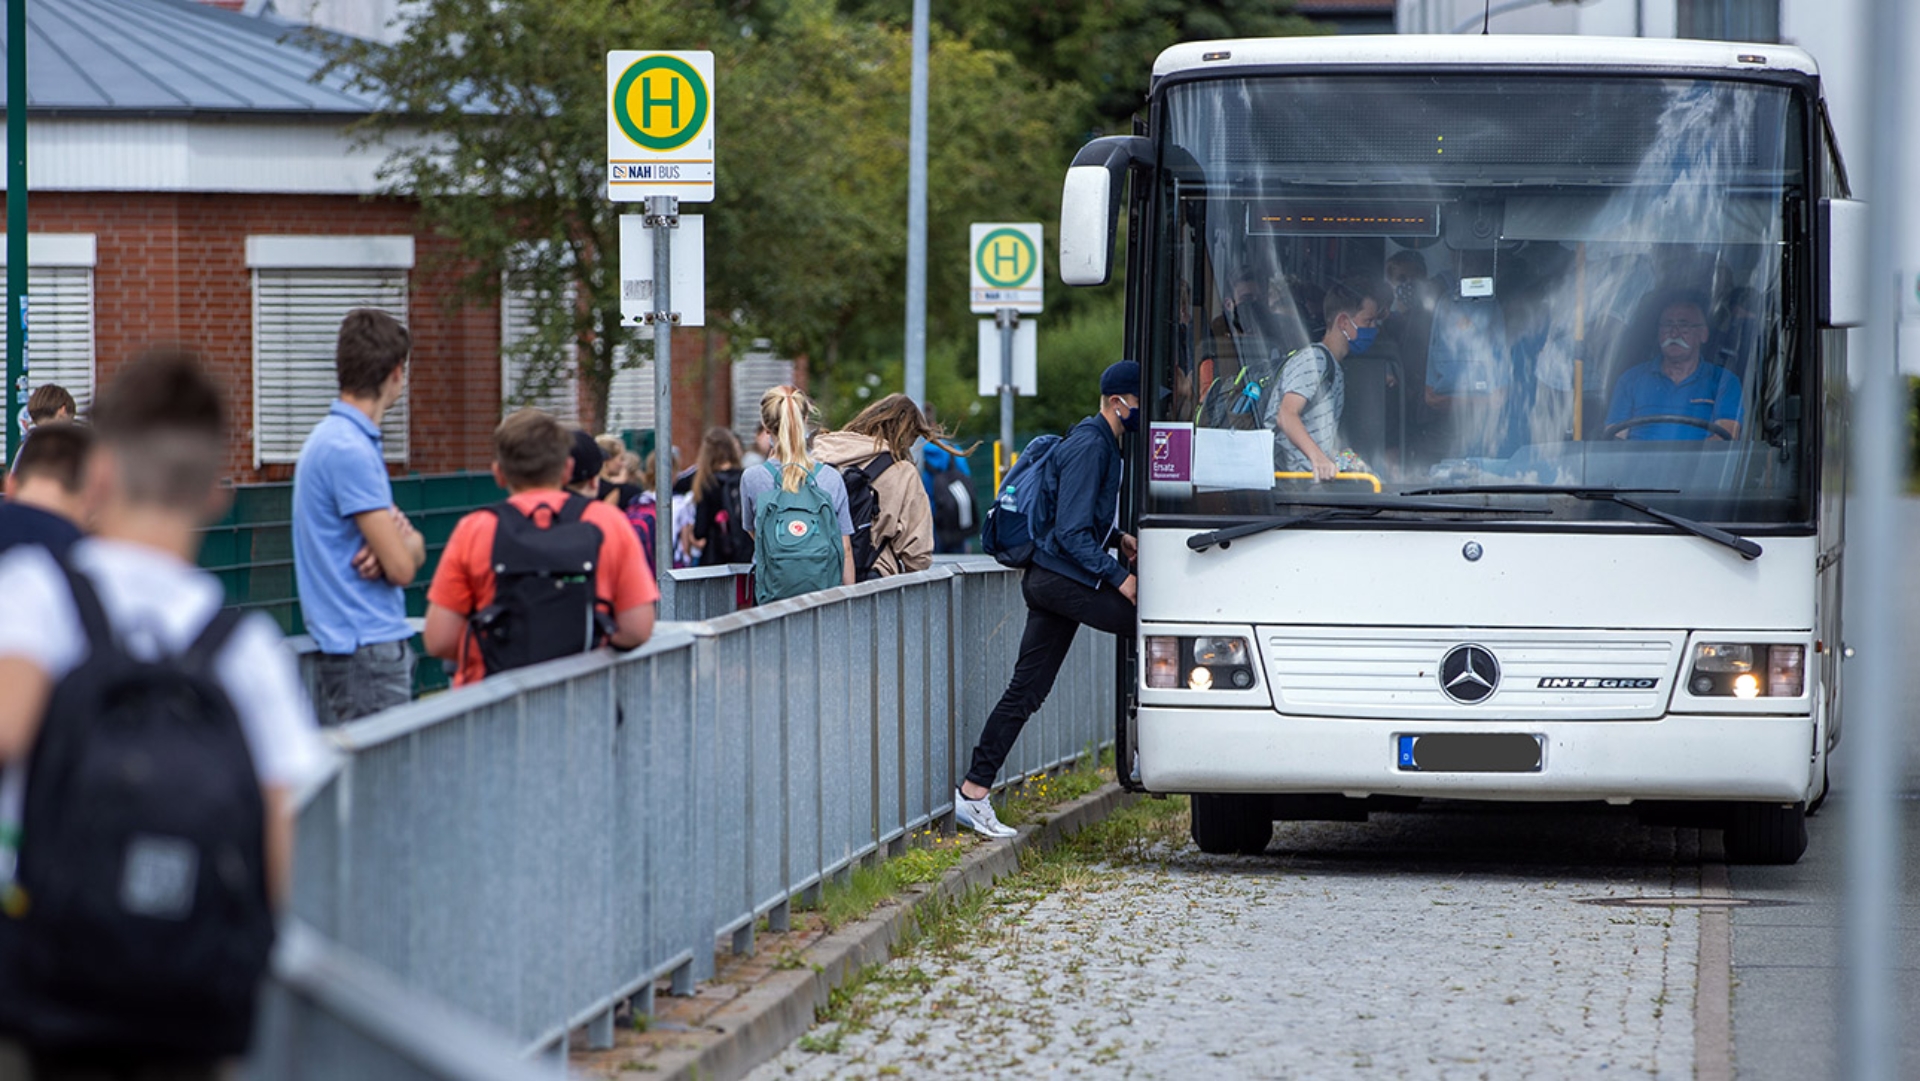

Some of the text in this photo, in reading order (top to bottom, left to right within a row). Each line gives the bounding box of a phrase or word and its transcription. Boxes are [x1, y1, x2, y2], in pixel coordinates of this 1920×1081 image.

[642, 77, 679, 128] H
[628, 165, 680, 179] NAH BUS
[994, 241, 1018, 276] H
[1153, 462, 1175, 472] Ersatz
[1542, 678, 1653, 688] INTEGRO
